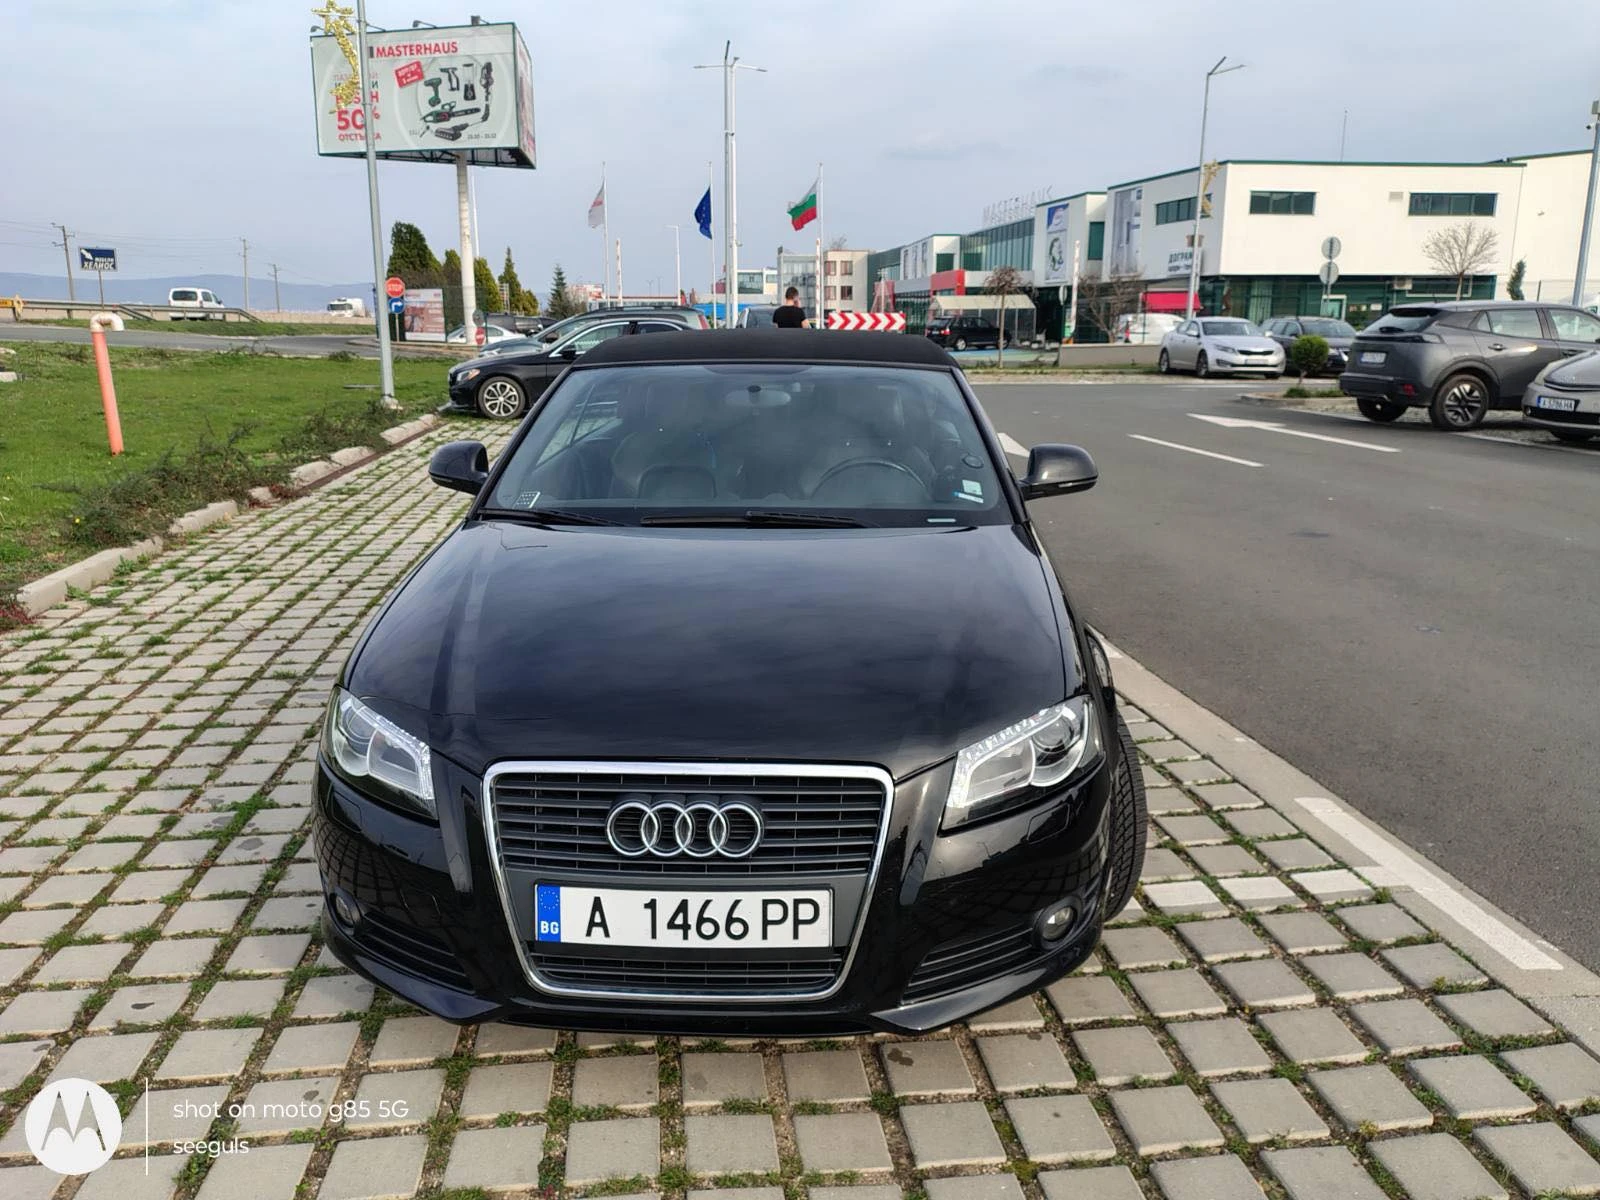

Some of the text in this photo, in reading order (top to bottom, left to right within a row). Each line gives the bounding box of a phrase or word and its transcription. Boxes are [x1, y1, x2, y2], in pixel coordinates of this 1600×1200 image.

[376, 41, 458, 57] MASTERHAUS
[83, 261, 115, 270] ХЕЛИОС
[387, 284, 402, 292] STOP
[585, 896, 820, 940] A 1466 PP
[540, 920, 560, 935] BG
